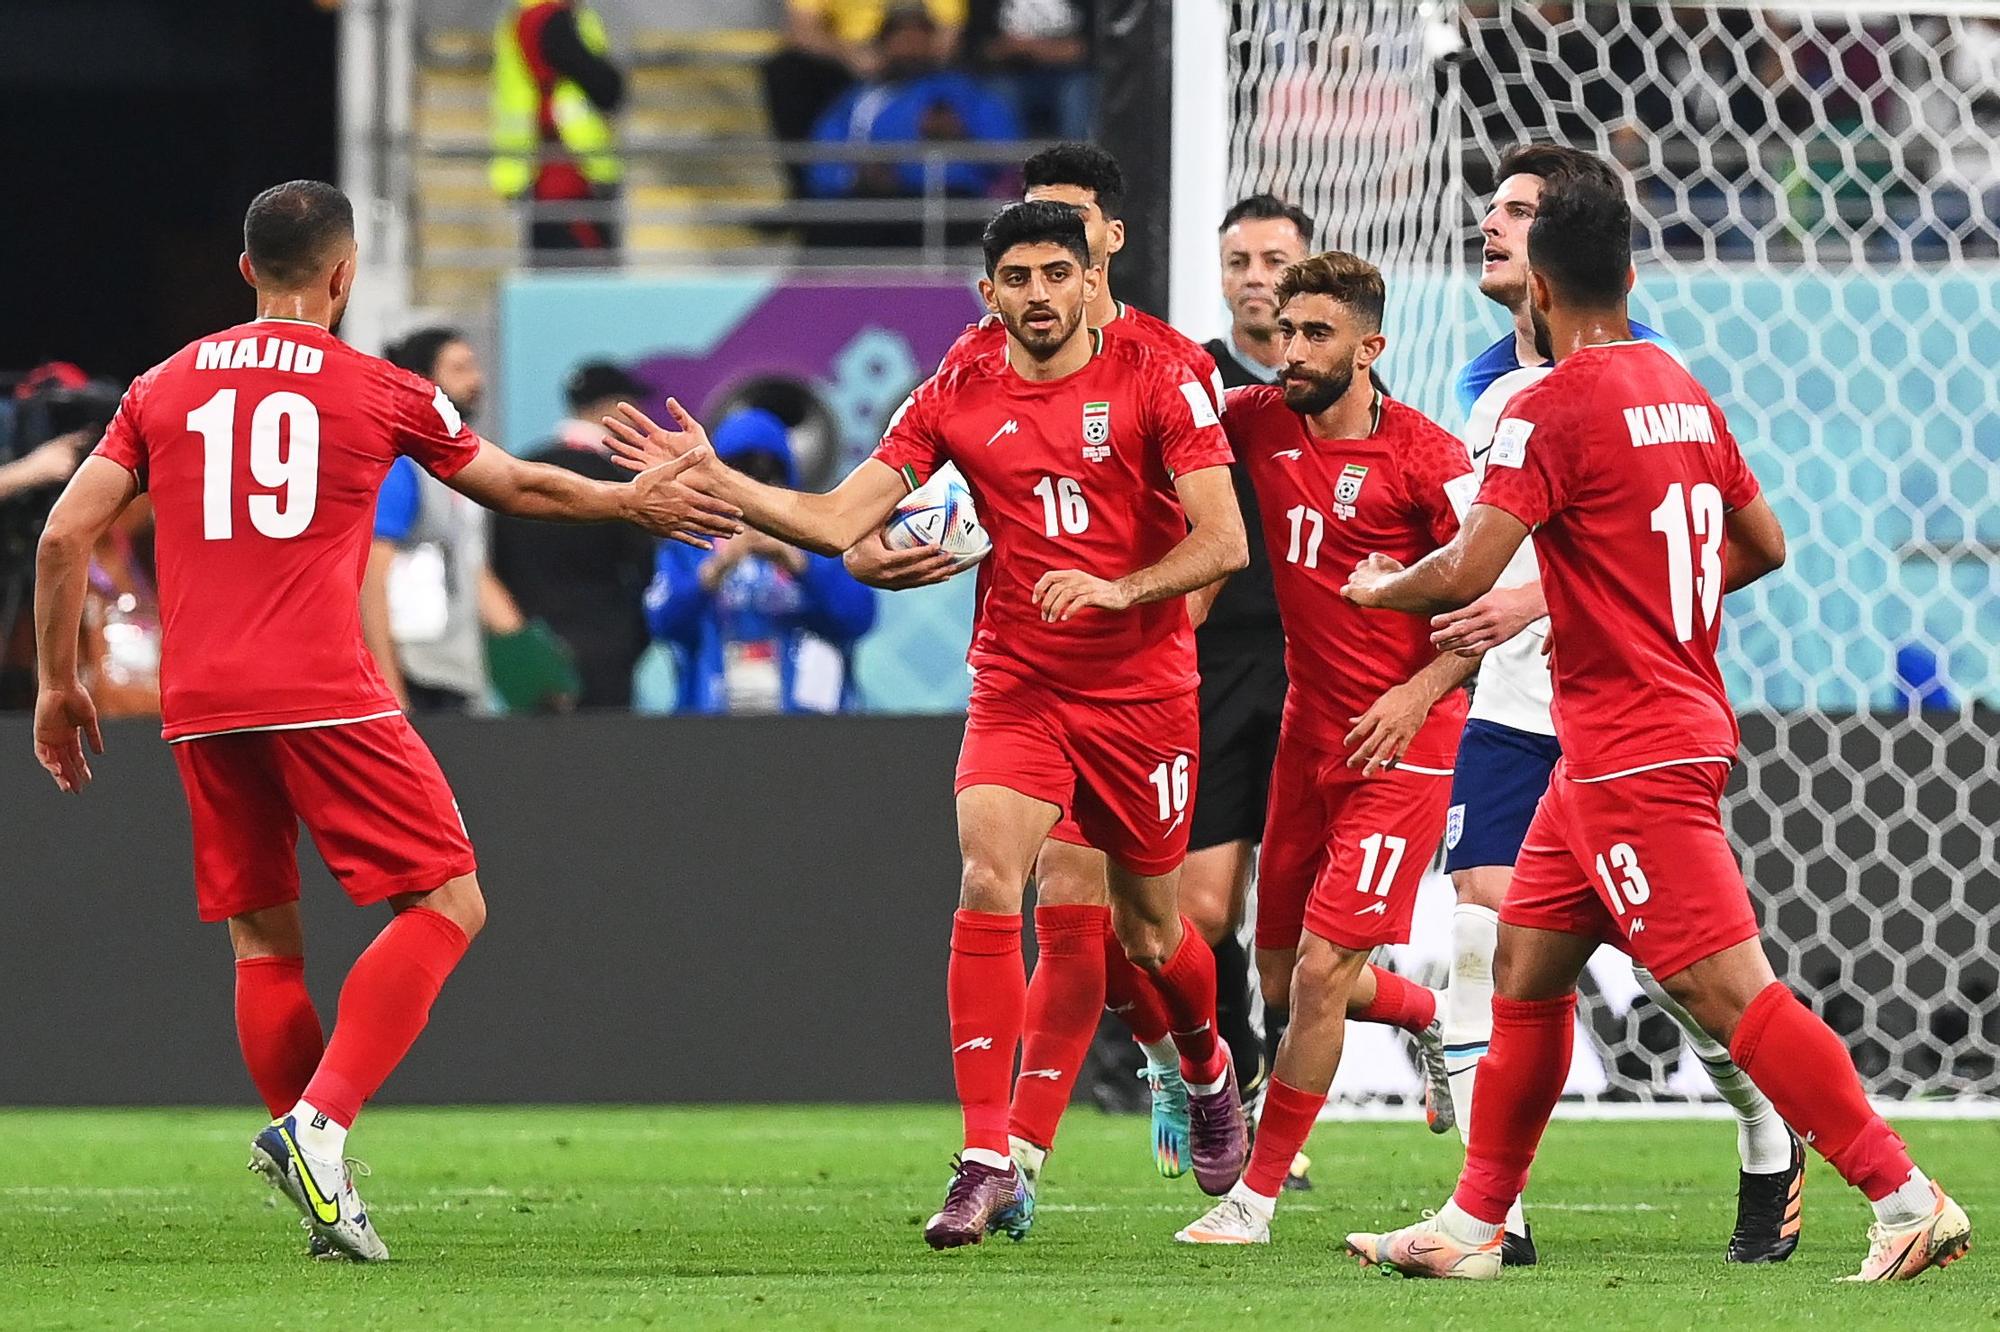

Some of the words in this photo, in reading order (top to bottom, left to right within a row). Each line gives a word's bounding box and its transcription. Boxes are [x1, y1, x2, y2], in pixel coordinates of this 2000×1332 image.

[194, 336, 324, 374] MAJID
[186, 388, 320, 540] 19
[1032, 476, 1090, 538] 16
[1286, 504, 1324, 569] 17
[1650, 482, 1724, 646] 13
[1148, 754, 1189, 821] 16
[1356, 832, 1407, 897] 17
[1595, 842, 1651, 916] 13
